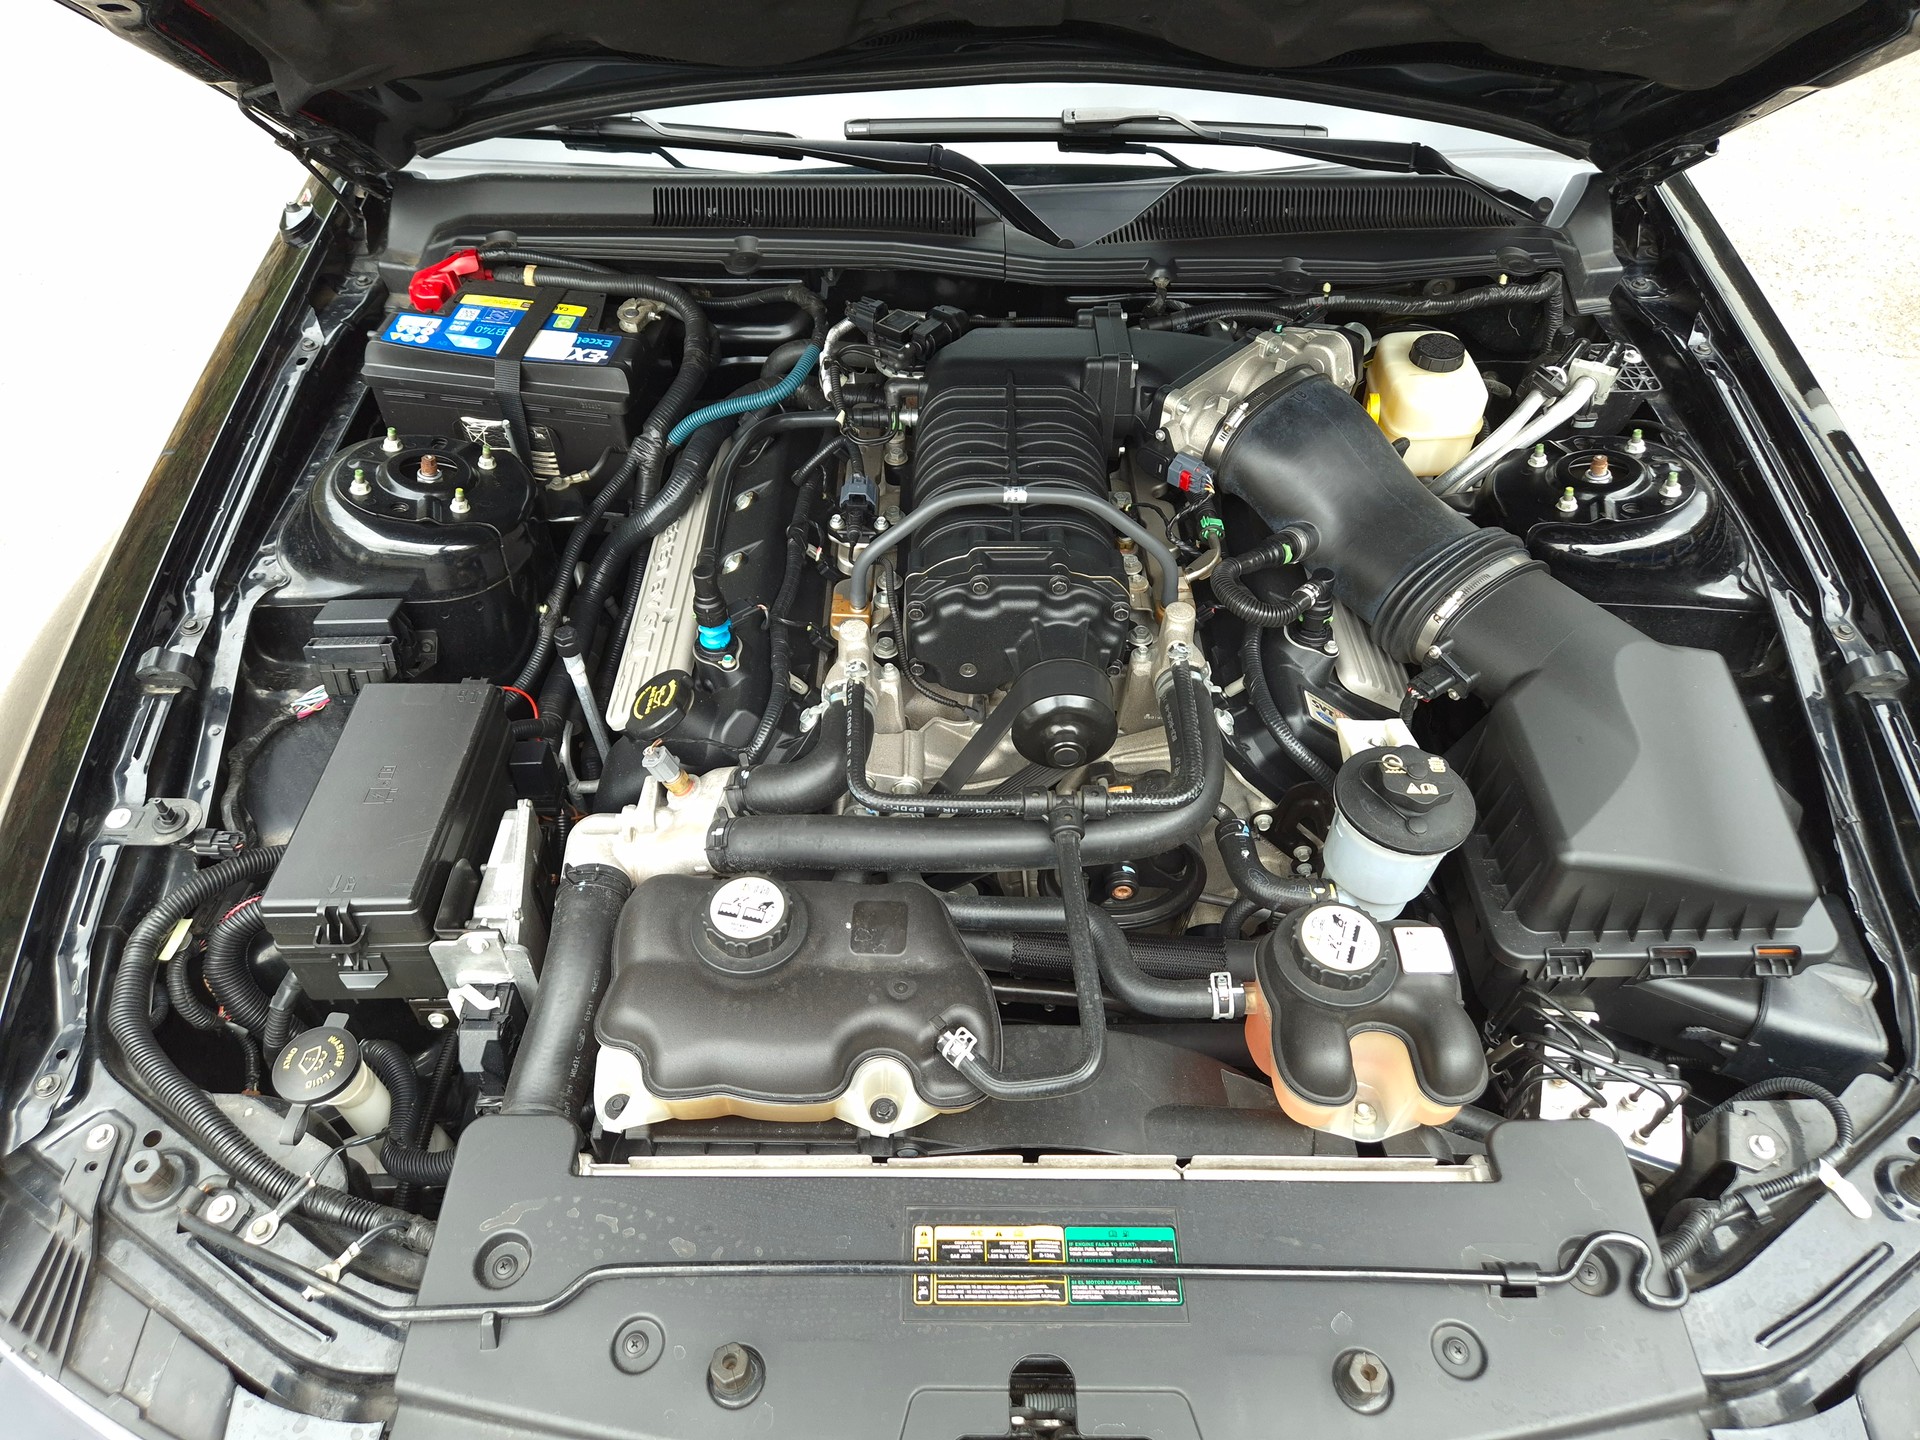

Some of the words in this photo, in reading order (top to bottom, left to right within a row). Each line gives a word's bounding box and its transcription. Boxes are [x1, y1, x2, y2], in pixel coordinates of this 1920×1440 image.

[282, 1047, 299, 1070] ONLY
[328, 1035, 347, 1067] WASHER
[304, 1069, 336, 1090] FLUID
